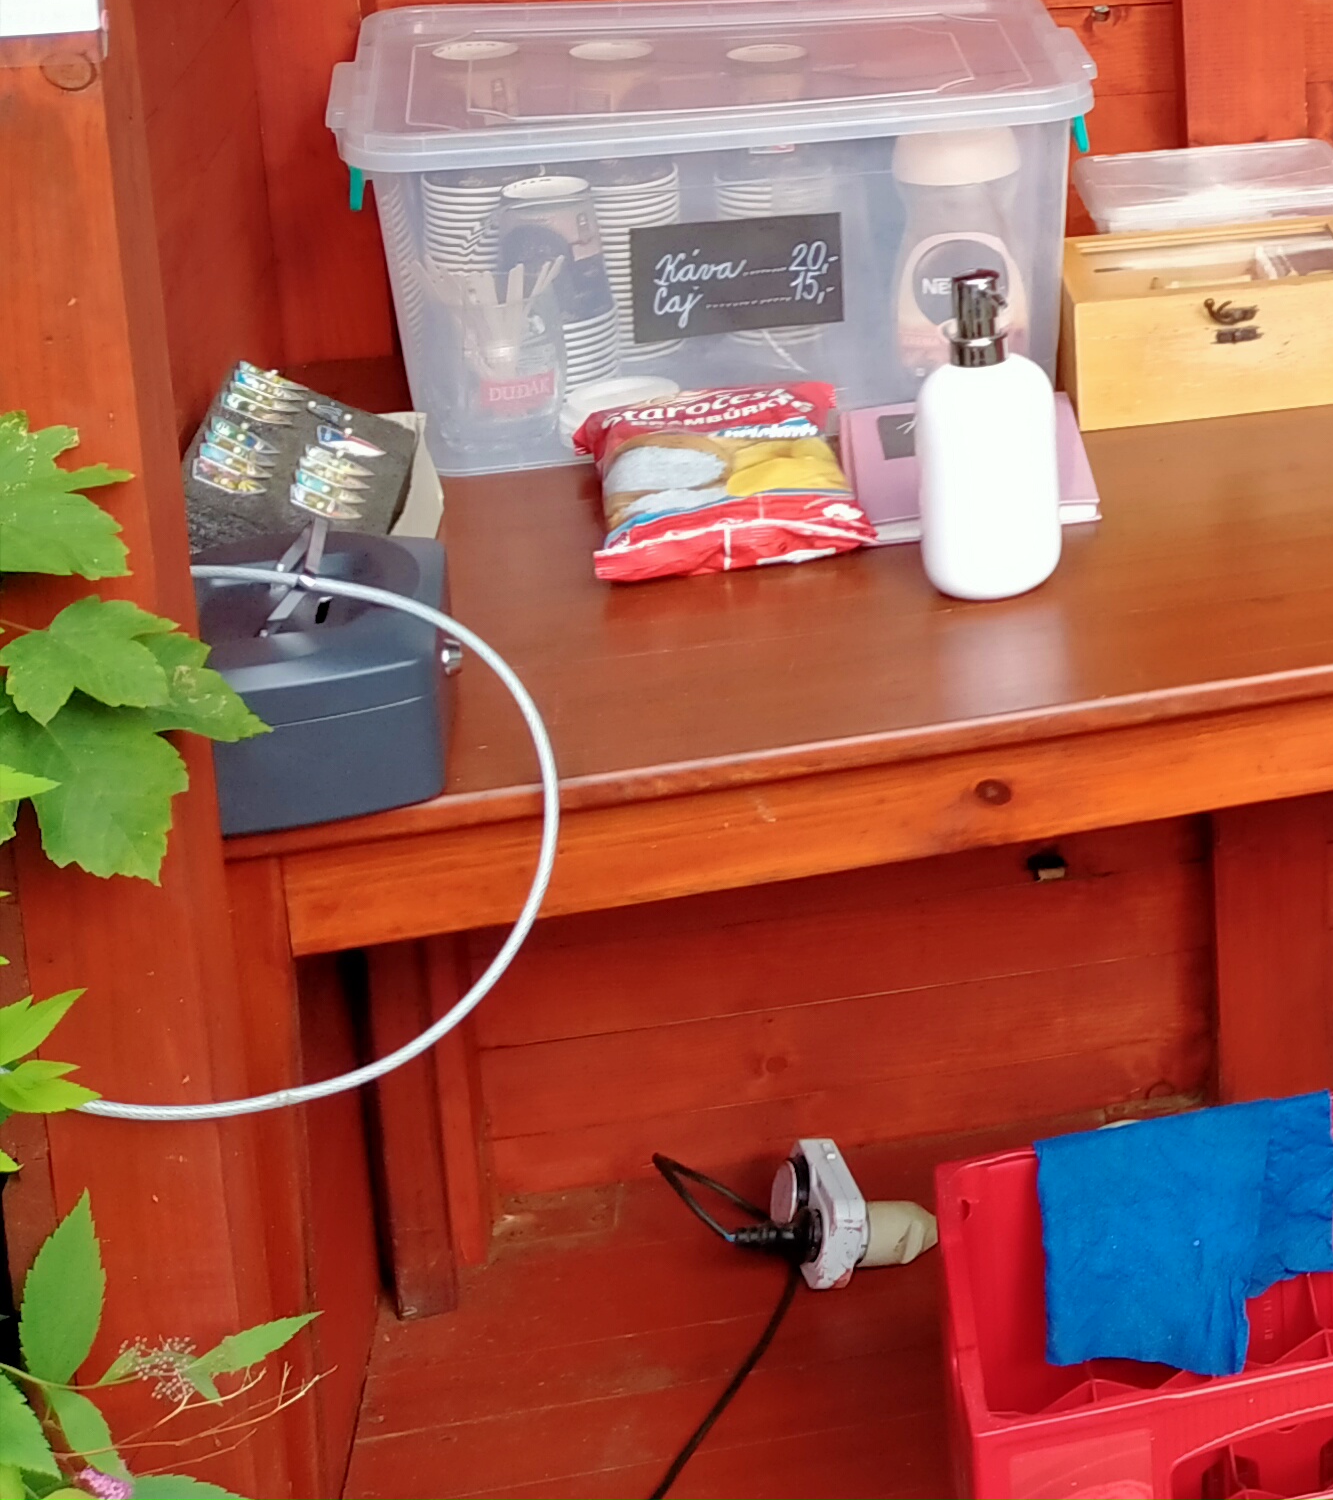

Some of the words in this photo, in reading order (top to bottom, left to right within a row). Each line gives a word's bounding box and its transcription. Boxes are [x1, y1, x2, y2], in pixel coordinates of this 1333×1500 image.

[654, 249, 748, 286] Káva
[788, 240, 839, 274] 20,-
[790, 271, 835, 305] 15,-
